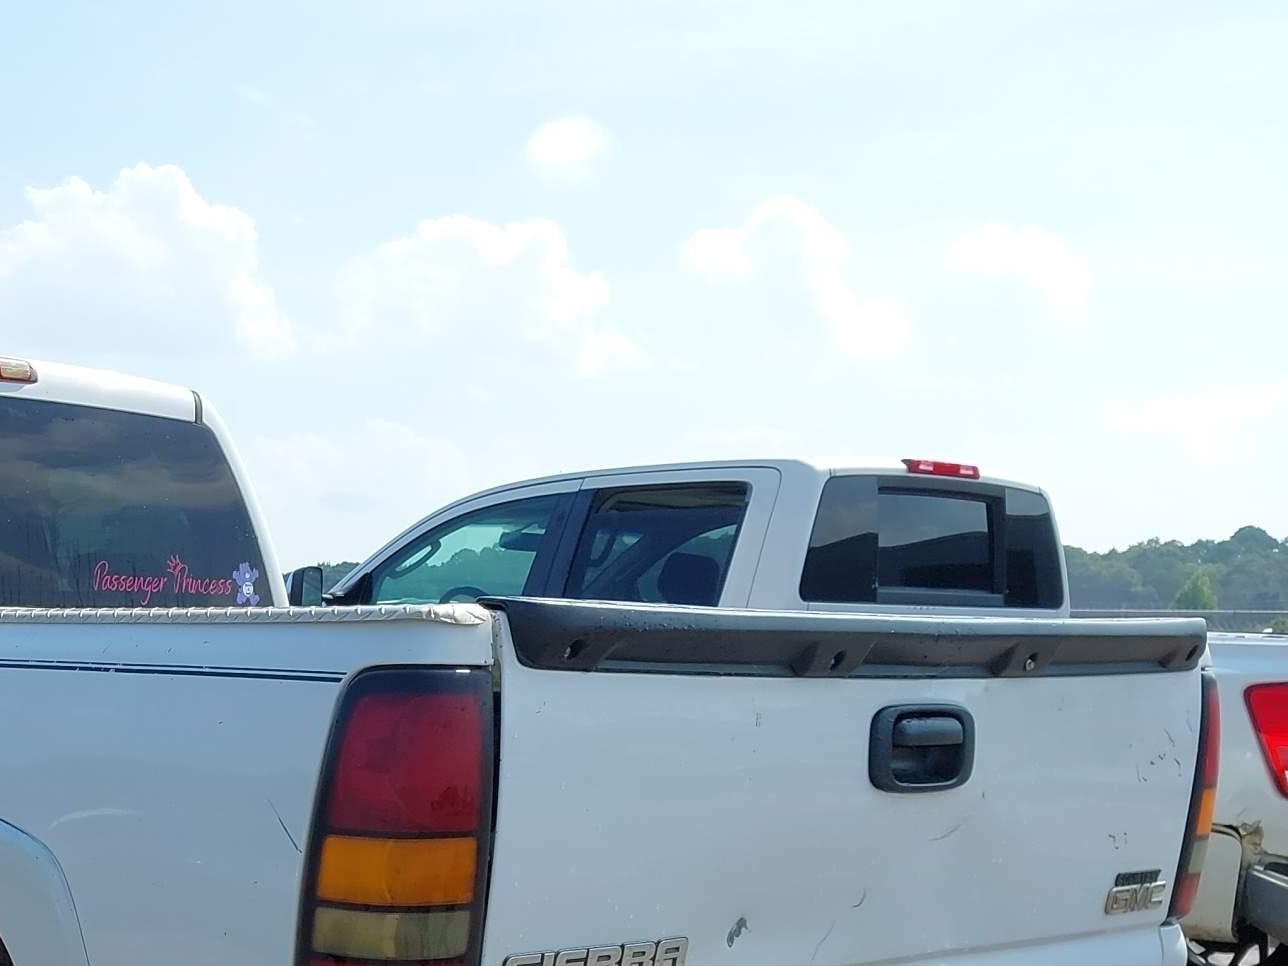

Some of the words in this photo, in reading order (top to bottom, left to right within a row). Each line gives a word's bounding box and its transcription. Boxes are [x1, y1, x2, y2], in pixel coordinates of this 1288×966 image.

[93, 560, 167, 605] Passenger
[173, 563, 233, 595] Princess
[1105, 881, 1166, 914] GMC
